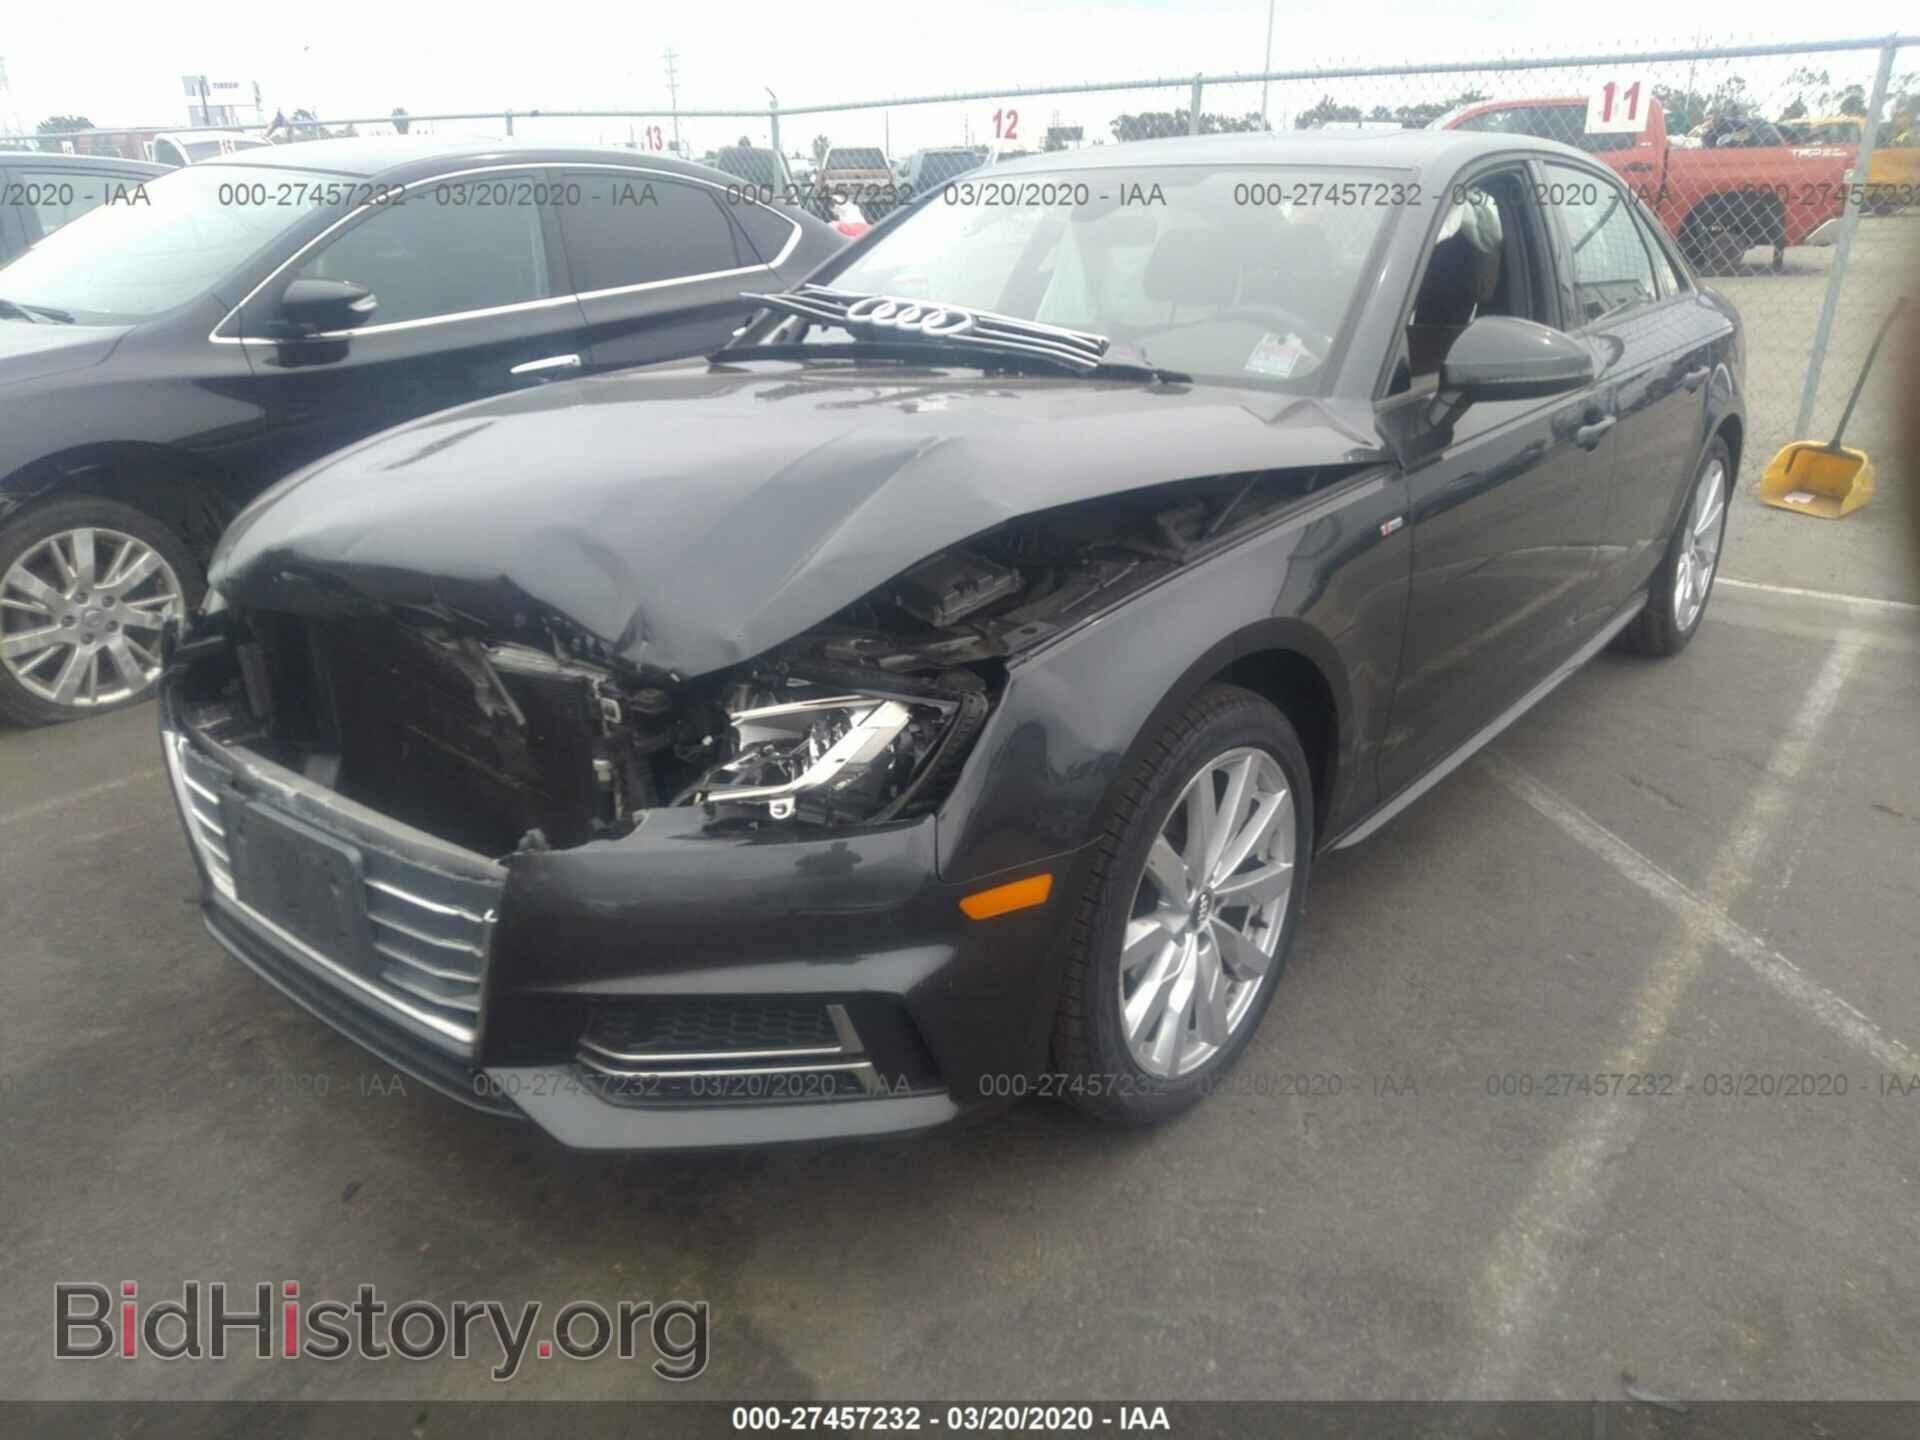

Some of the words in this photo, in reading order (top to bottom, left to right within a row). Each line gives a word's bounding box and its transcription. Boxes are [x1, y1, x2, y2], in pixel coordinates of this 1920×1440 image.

[1603, 81, 1641, 122] 11
[645, 125, 663, 151] 13
[992, 108, 1018, 139] 12
